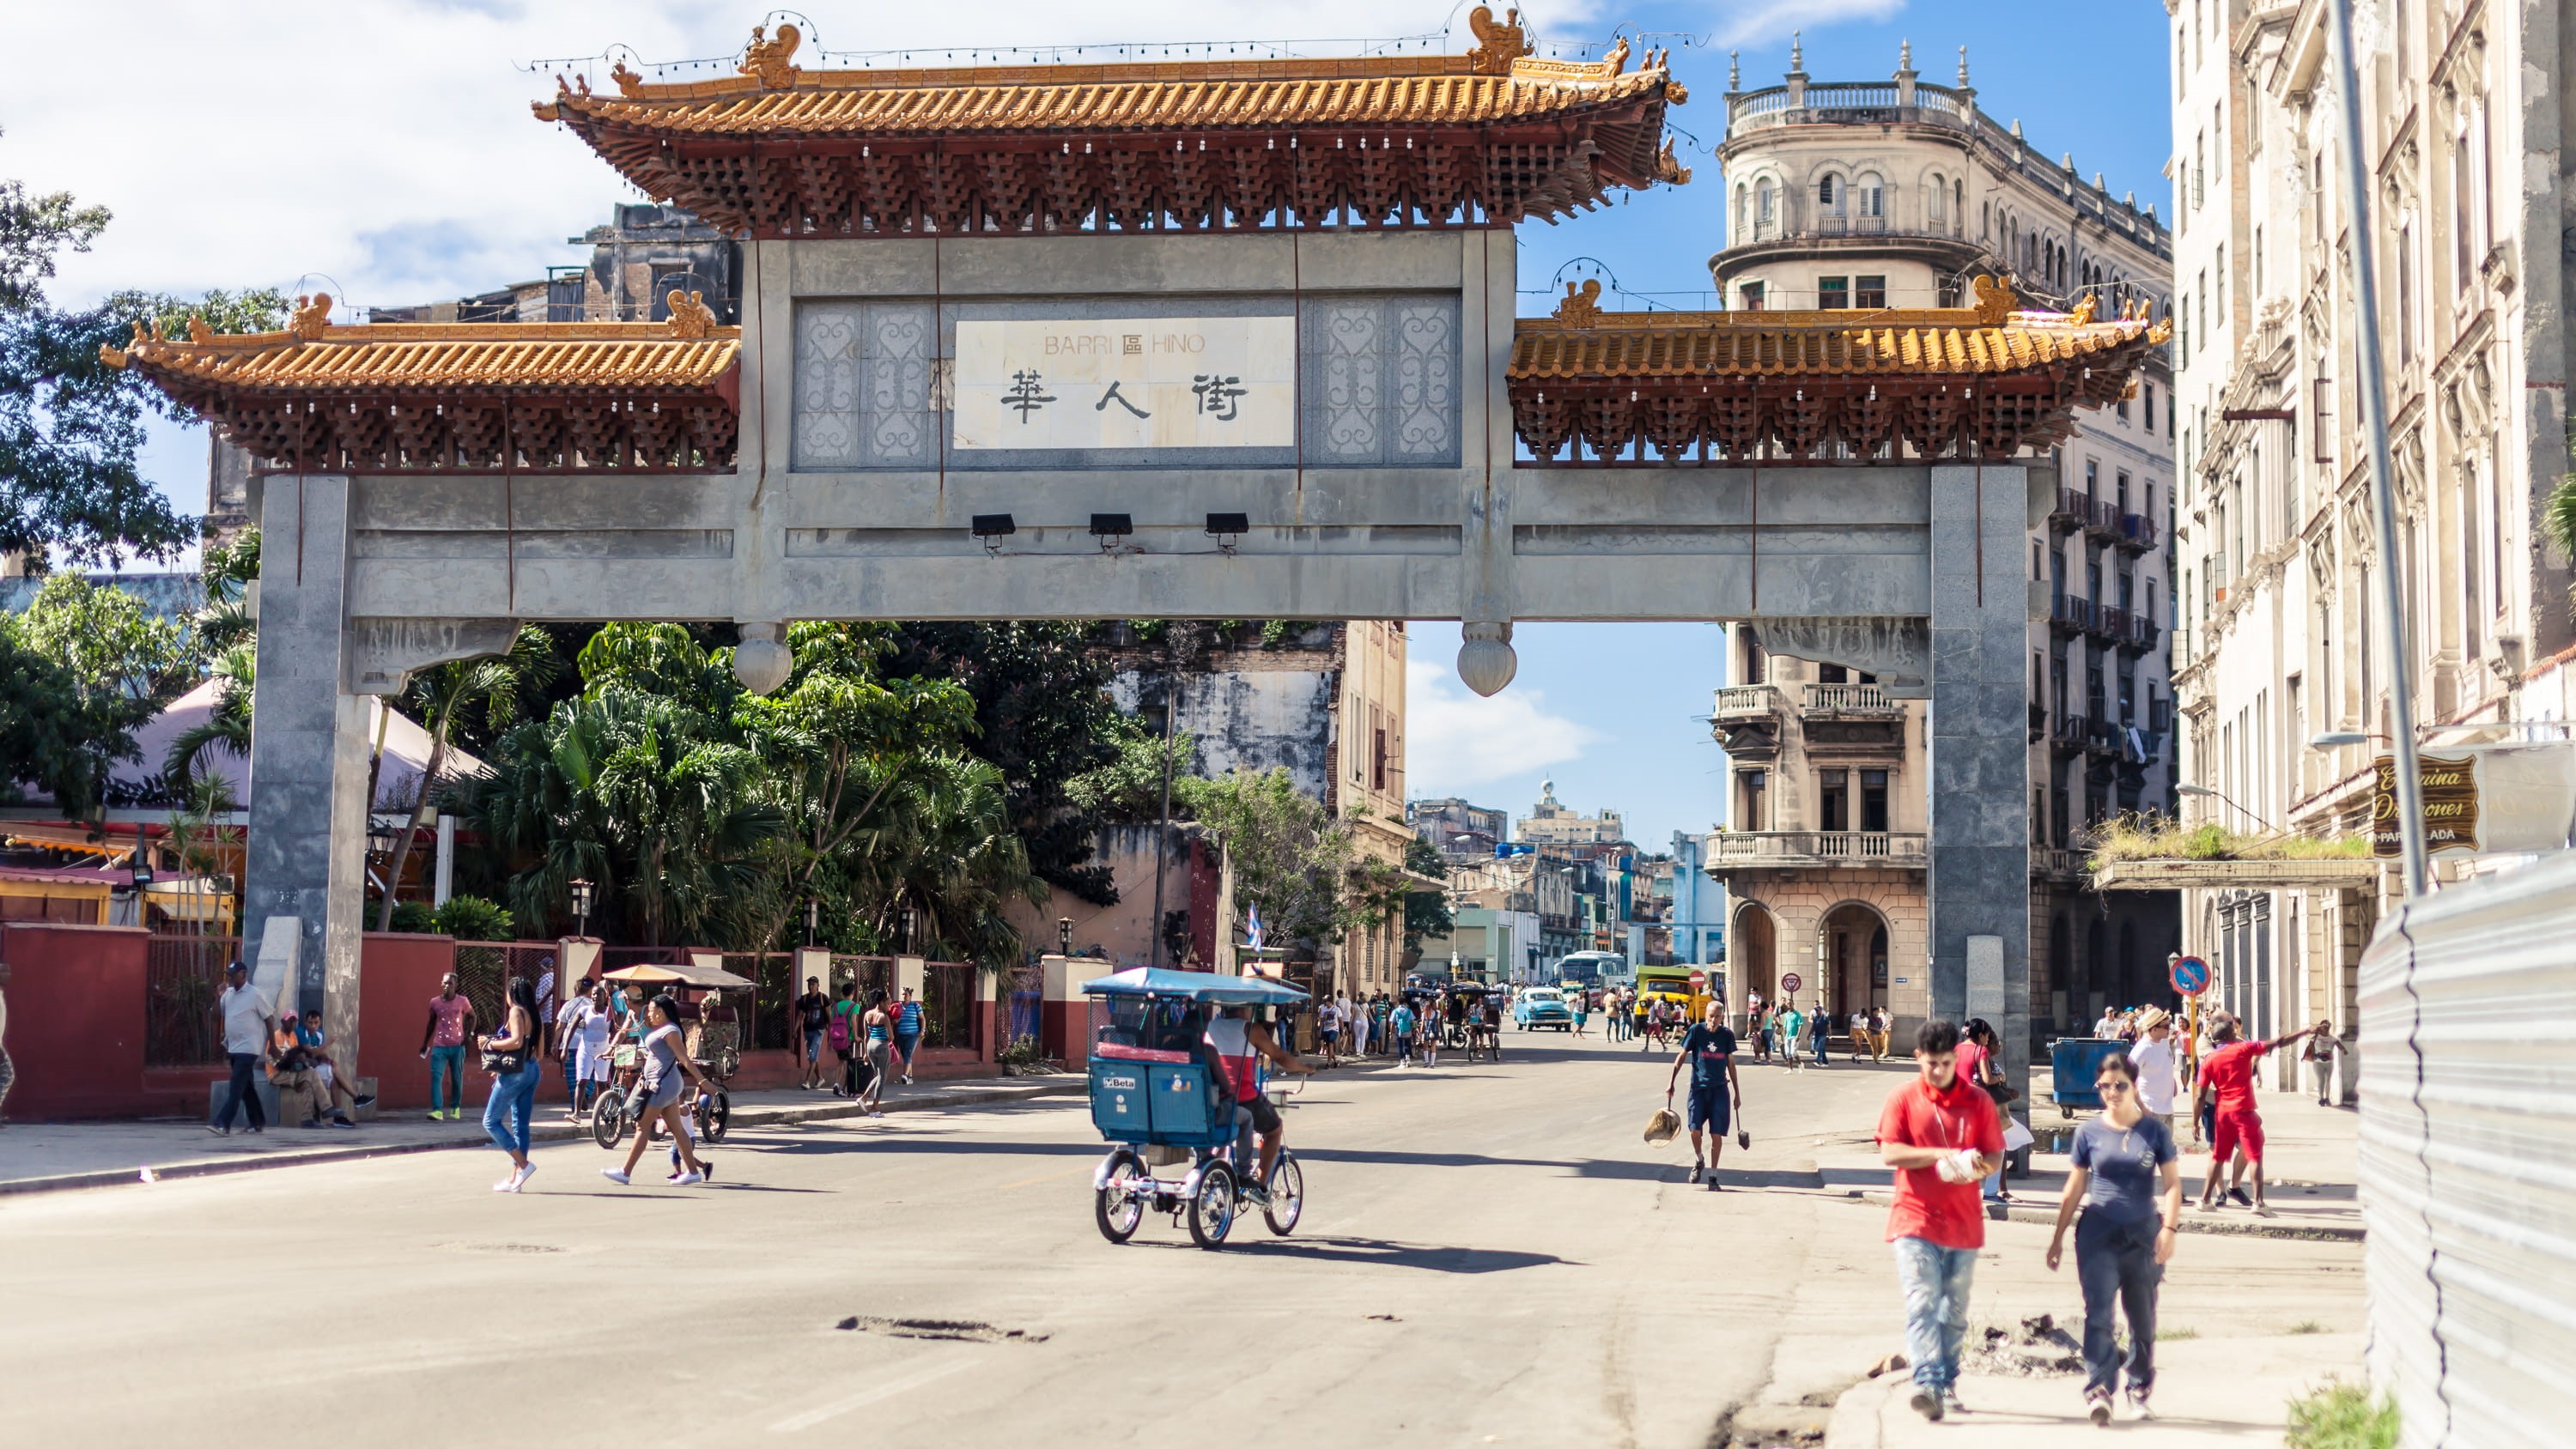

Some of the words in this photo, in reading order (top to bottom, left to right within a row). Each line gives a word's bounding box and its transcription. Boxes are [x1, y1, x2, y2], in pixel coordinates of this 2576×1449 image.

[1044, 335, 1112, 355] BARRI
[1151, 333, 1206, 354] HINO
[2380, 765, 2462, 791] Euina
[2374, 793, 2464, 820] Drones
[1113, 1079, 1134, 1088] Beta
